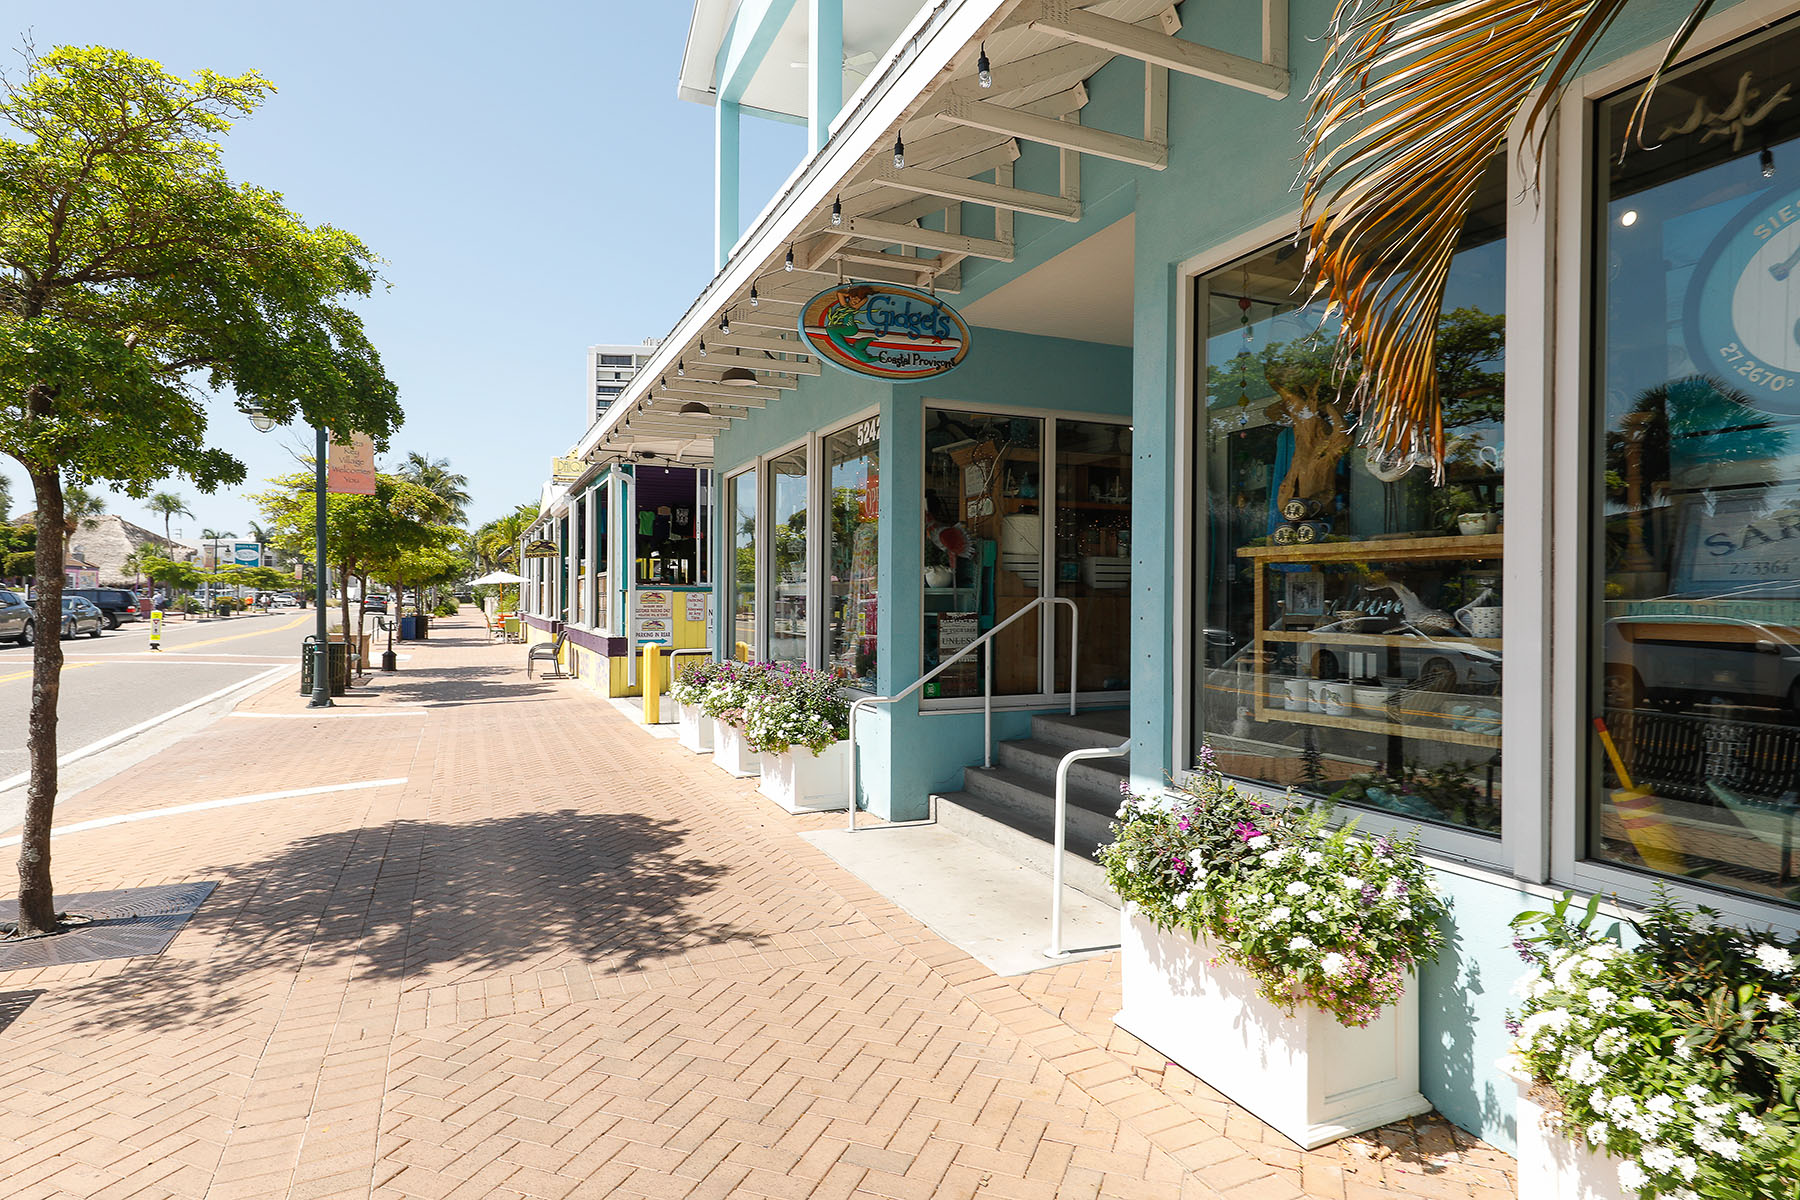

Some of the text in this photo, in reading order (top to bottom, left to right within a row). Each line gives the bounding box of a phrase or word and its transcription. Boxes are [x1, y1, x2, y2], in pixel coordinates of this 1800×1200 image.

[1753, 200, 1800, 240] SIE
[879, 351, 911, 368] Coastal
[339, 456, 365, 468] Village
[343, 476, 360, 484] You
[942, 637, 976, 645] UNLESS
